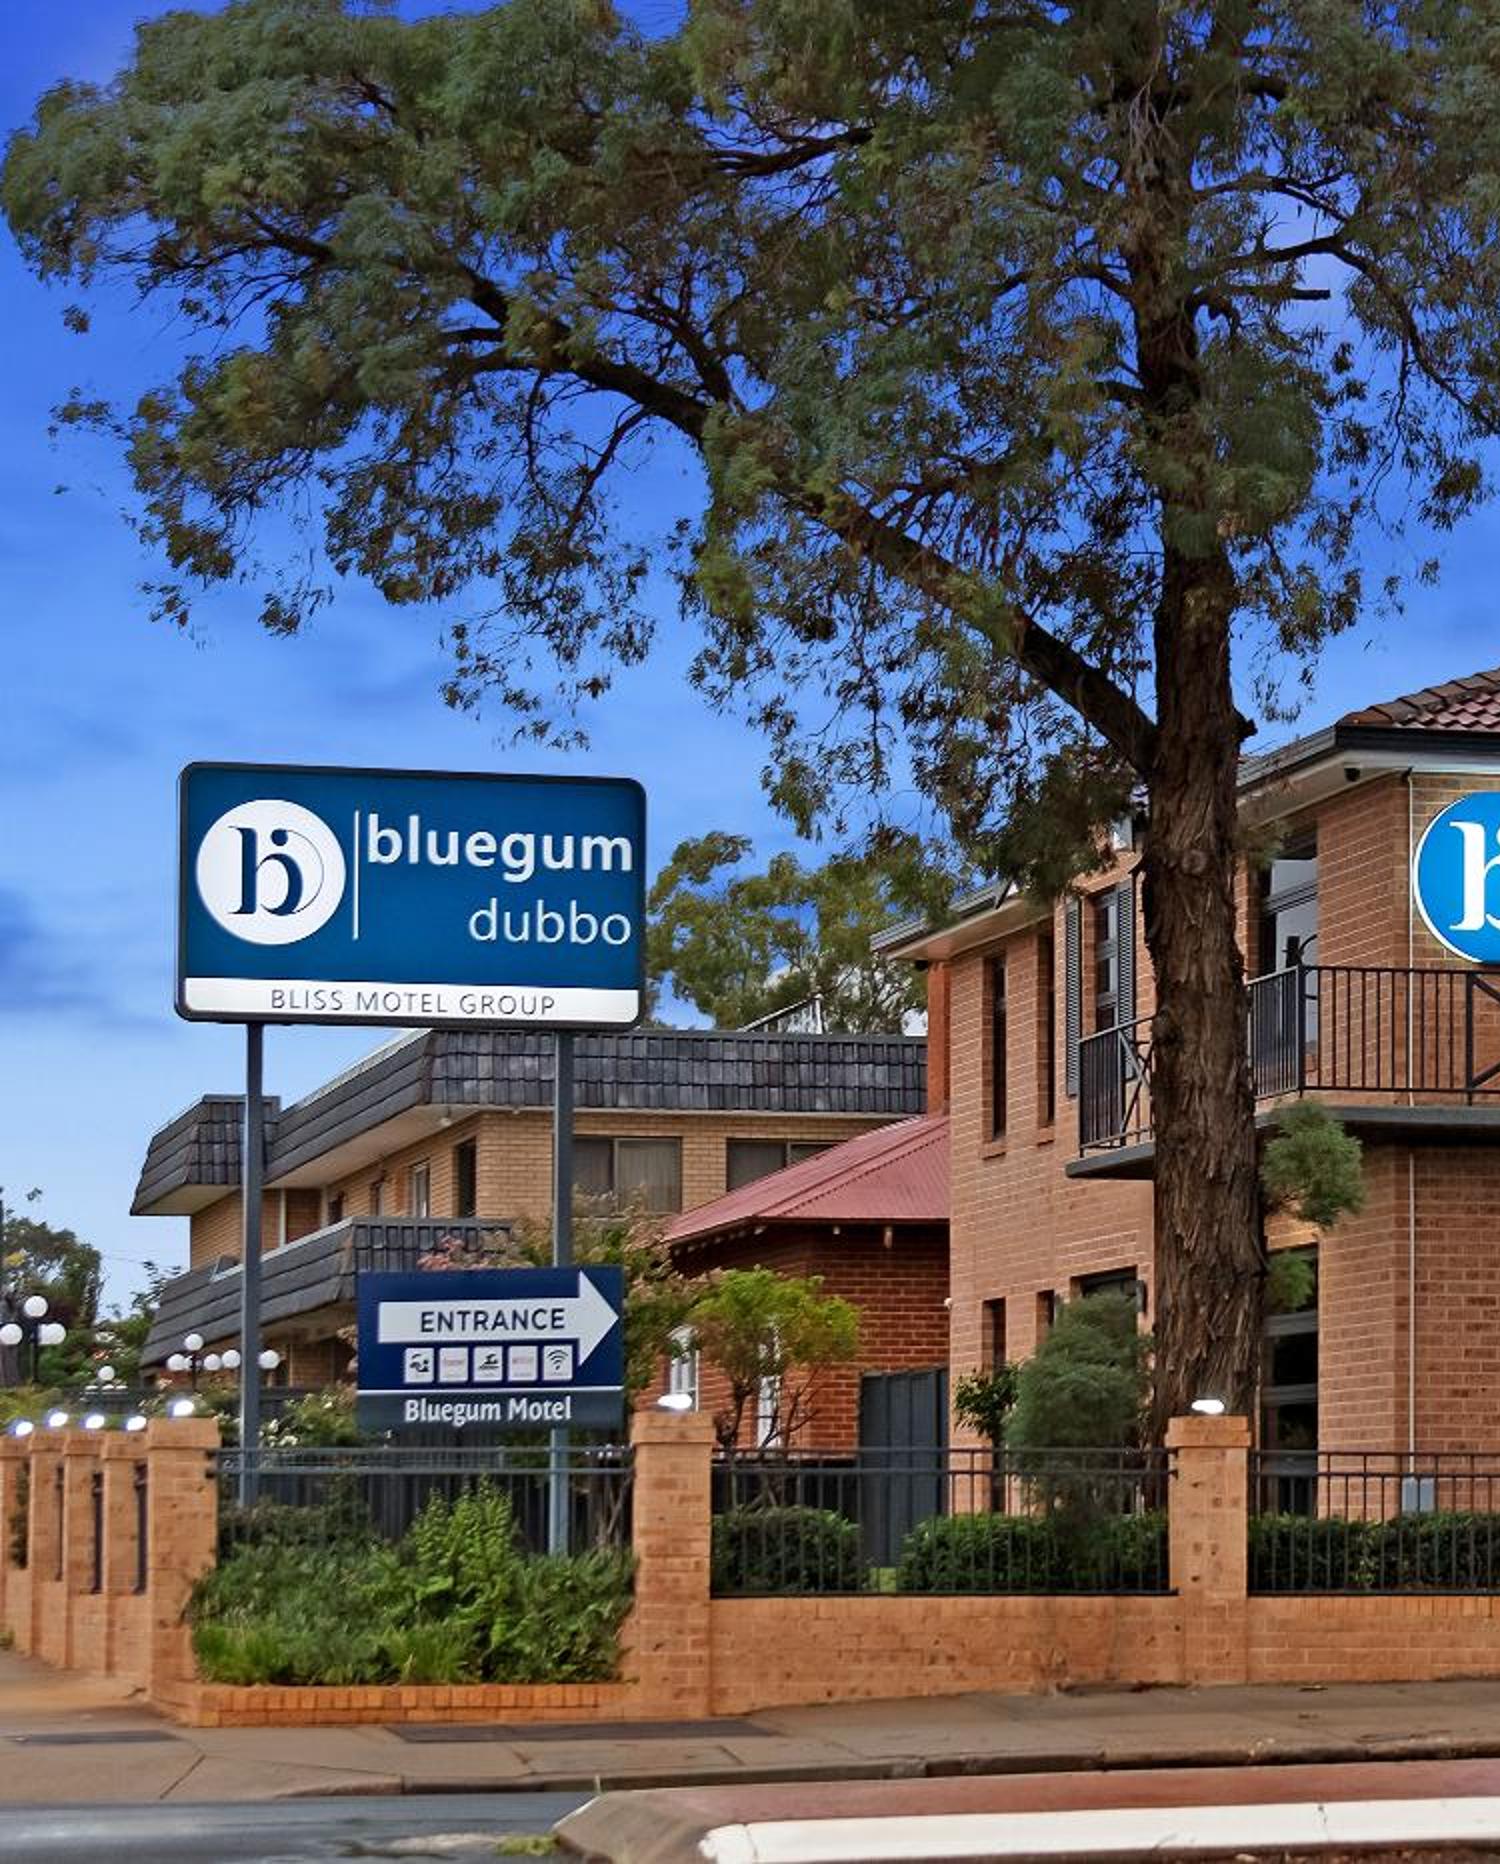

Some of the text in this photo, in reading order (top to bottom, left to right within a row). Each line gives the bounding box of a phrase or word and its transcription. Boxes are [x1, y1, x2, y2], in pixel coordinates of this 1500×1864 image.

[367, 813, 632, 883] bluegum
[468, 898, 632, 946] dubbo
[270, 988, 556, 1017] BLISS MOTEL GROUP
[420, 1308, 566, 1333] ENTRANCE
[404, 1395, 572, 1427] Bluegum Motel
